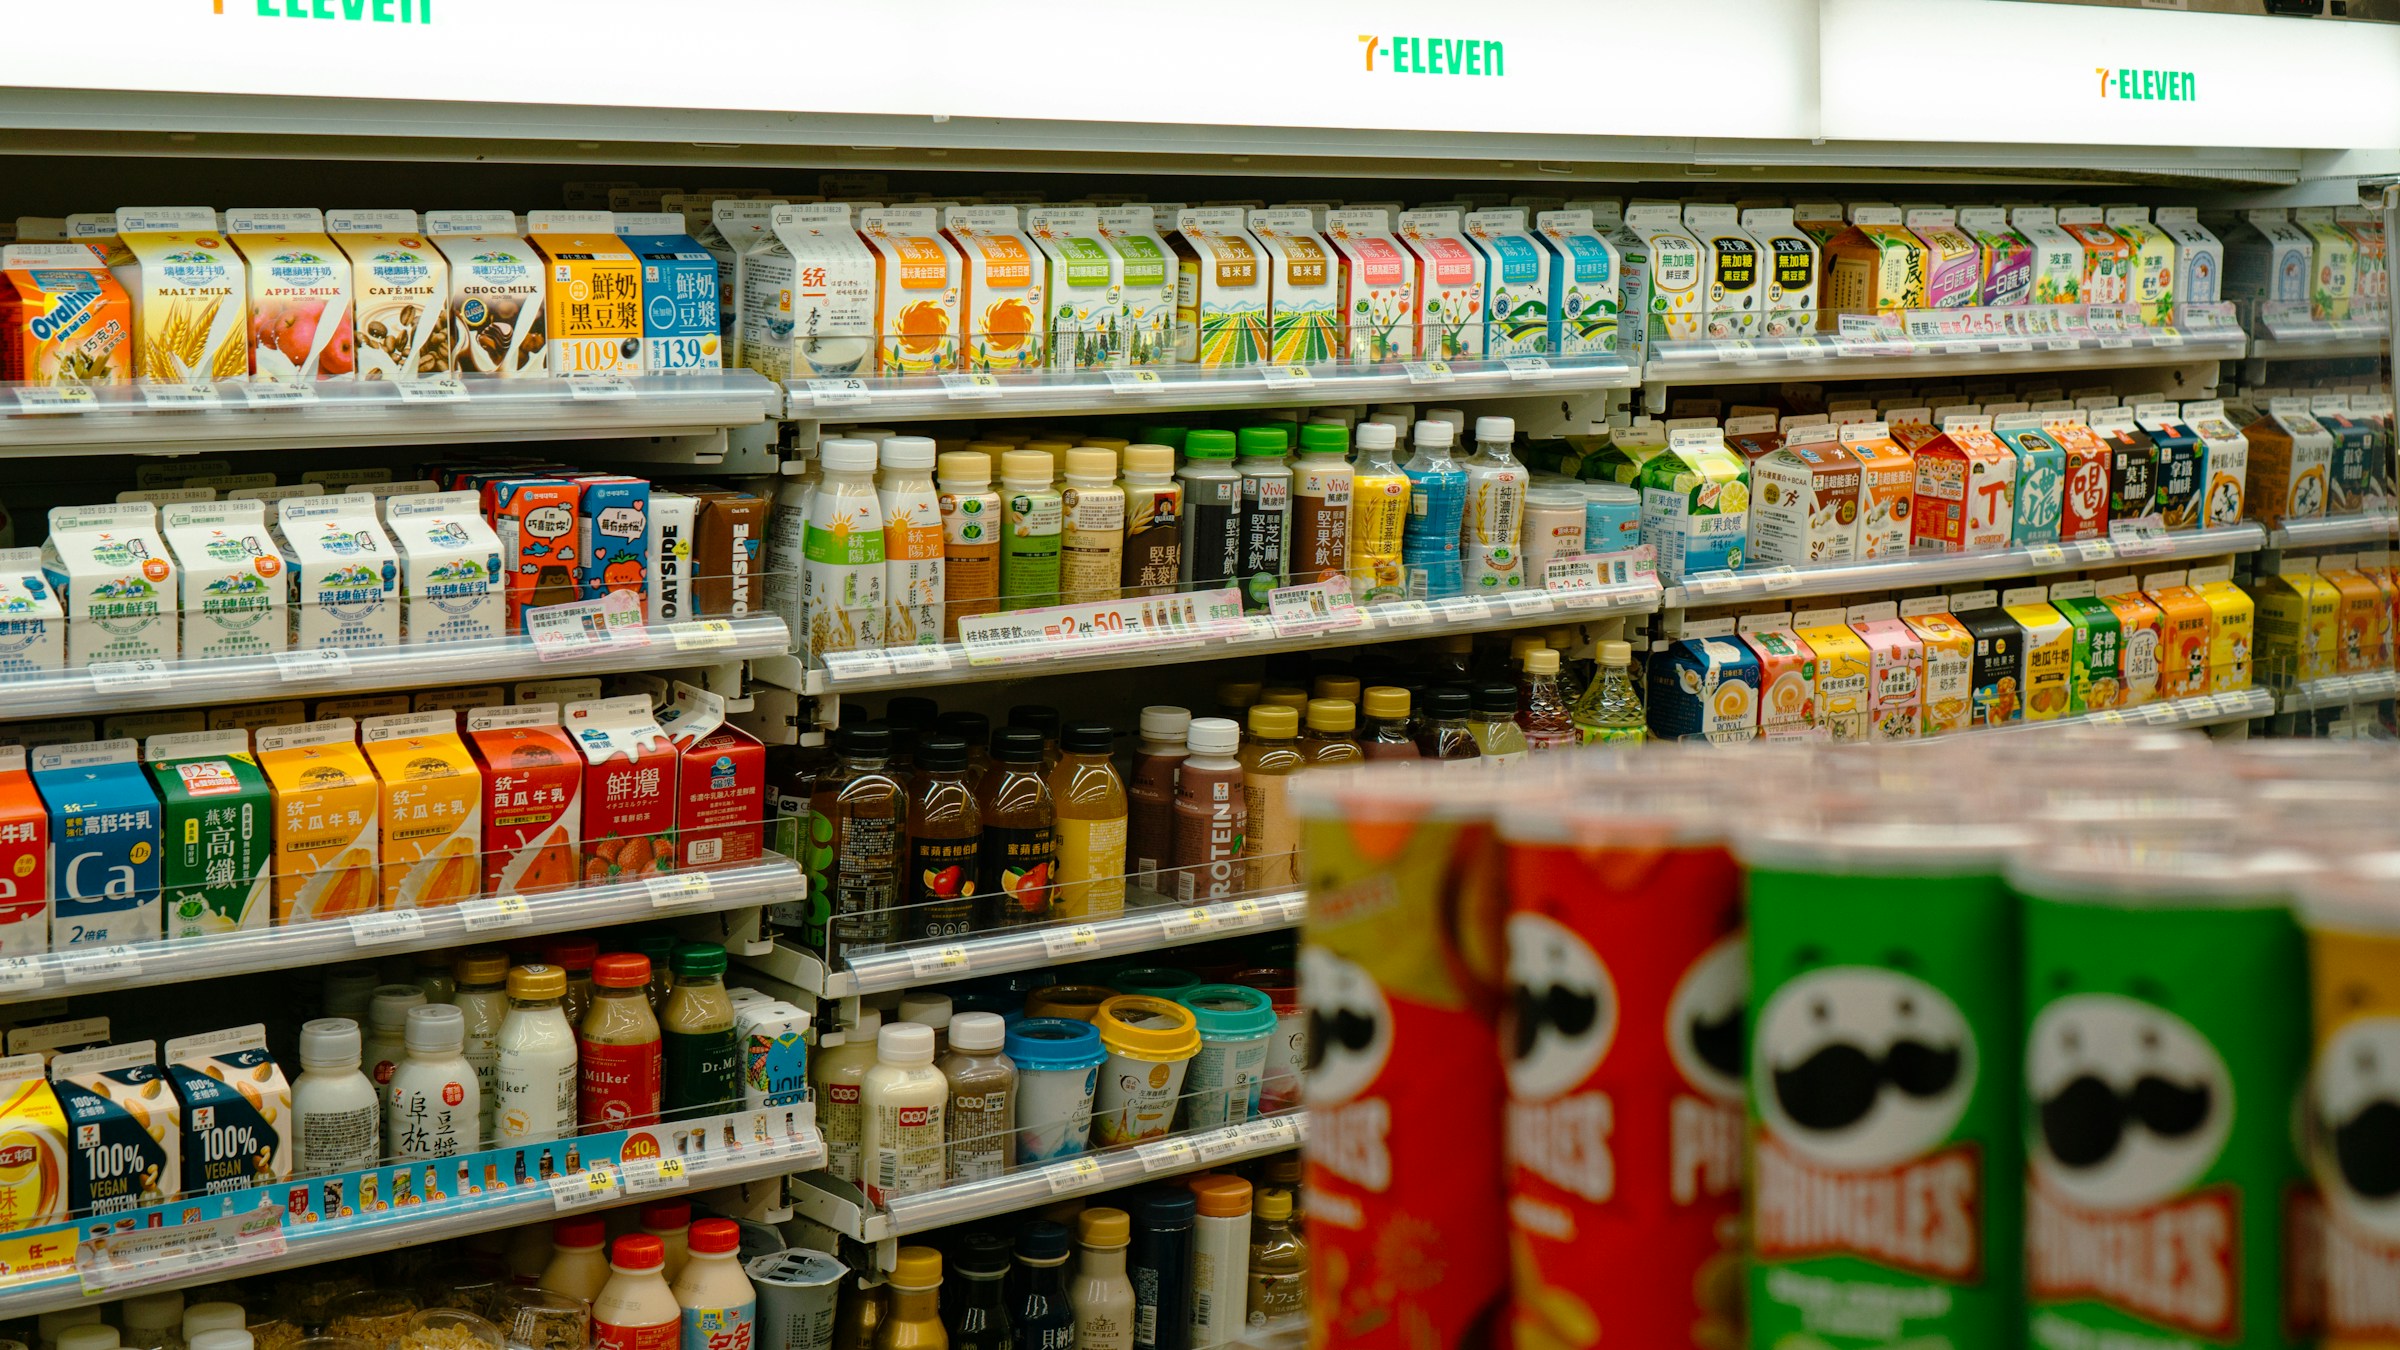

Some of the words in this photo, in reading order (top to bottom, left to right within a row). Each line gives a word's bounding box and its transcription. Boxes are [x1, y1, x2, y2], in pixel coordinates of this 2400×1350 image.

[1659, 239, 1691, 250] 光泉
[1662, 254, 1695, 268] 無加糖
[1721, 254, 1752, 268] 無加糖
[1778, 254, 1809, 268] 無加糖
[2049, 253, 2072, 265] 波蜜
[2144, 255, 2163, 266] 波蜜
[1665, 269, 1690, 280] 鮮豆漿
[1723, 270, 1749, 282] 黑豆漿
[1781, 270, 1806, 282] 黑豆漿
[1932, 264, 1977, 292] 一日蔬果
[1985, 265, 2030, 295] 一日蔬果
[159, 287, 195, 297] MALT
[200, 287, 233, 297] MILK
[265, 288, 306, 297] APPLE
[311, 287, 341, 297] MILK
[369, 286, 402, 296] CAFÉ
[404, 286, 434, 296] MILK
[464, 286, 505, 296] CHOCO
[508, 286, 538, 296] MILK
[592, 273, 638, 301] 鮮奶
[676, 273, 714, 299] 鮮奶
[570, 302, 639, 331] 黑豆漿
[678, 302, 717, 329] 豆漿
[83, 320, 120, 352] 巧克力
[1911, 322, 1939, 336] 蔬果汁
[571, 340, 618, 371] 10.9
[661, 339, 700, 369] 13.9
[844, 379, 860, 390] 25
[977, 374, 991, 384] 25
[1261, 482, 1286, 496] Viva
[1327, 479, 1349, 492] Viva
[2124, 482, 2148, 500] 咖啡
[2169, 477, 2192, 495] 咖啡
[1261, 496, 1285, 508] 萬歲牌
[1154, 515, 1176, 524] QUAKER
[1497, 486, 1512, 544] 純濃燕麥
[908, 530, 939, 544] 統一
[1248, 513, 1266, 571] 堅果飲
[1264, 524, 1280, 562] 芝麻
[1315, 510, 1331, 566] 堅果飲
[1331, 518, 1344, 557] 綜合
[849, 550, 880, 563] 陽光
[908, 545, 939, 558] 陽光
[1149, 546, 1179, 566] 堅果
[661, 525, 678, 618] OATSIDE
[732, 523, 749, 618] OATSIDE
[608, 610, 640, 626] 春日賞
[1208, 603, 1240, 619] 春日賞
[711, 623, 724, 633] 39
[2031, 649, 2070, 668] 地瓜牛奶
[1930, 661, 1968, 679] 焦糖海鹽
[1940, 678, 1957, 692] 奶茶
[1716, 721, 1743, 732] ROYAL
[1710, 733, 1733, 745] MILK
[1734, 731, 1751, 743] TEA
[495, 775, 528, 792] 統一
[495, 788, 565, 808] 西瓜牛乳
[204, 807, 237, 827] 燕麥
[393, 800, 465, 822] 木瓜牛乳
[613, 812, 651, 824] 草莓鮮奶茶
[84, 810, 152, 836] 高鈣牛乳
[287, 811, 363, 833] 木瓜牛乳
[205, 827, 238, 891] 高纖
[1210, 803, 1232, 905] ROTEIN
[65, 852, 136, 904] Ca
[1077, 926, 1091, 937] 45
[946, 946, 960, 958] 45
[9, 957, 28, 970] 34
[186, 1079, 215, 1091] 100%
[71, 1095, 101, 1108] 100%
[192, 1089, 220, 1100] 全植物
[23, 1104, 52, 1112] ORIGINAL
[25, 1111, 38, 1119] MILK
[40, 1110, 53, 1118] TEA
[77, 1106, 105, 1118] 全植物
[900, 1109, 927, 1123] 無色素
[1271, 1118, 1283, 1129] 30
[1223, 1127, 1238, 1139] 30
[200, 1125, 257, 1163] 100%
[624, 1140, 657, 1158] +10元
[0, 1147, 33, 1164] 立頓
[85, 1144, 144, 1181] 100%
[205, 1159, 241, 1180] VEGAN
[663, 1159, 679, 1172] 40
[206, 1174, 250, 1196] PROTEIN
[590, 1172, 607, 1185] 40
[90, 1178, 128, 1199] VEGAN
[91, 1193, 138, 1216] PROTEIN
